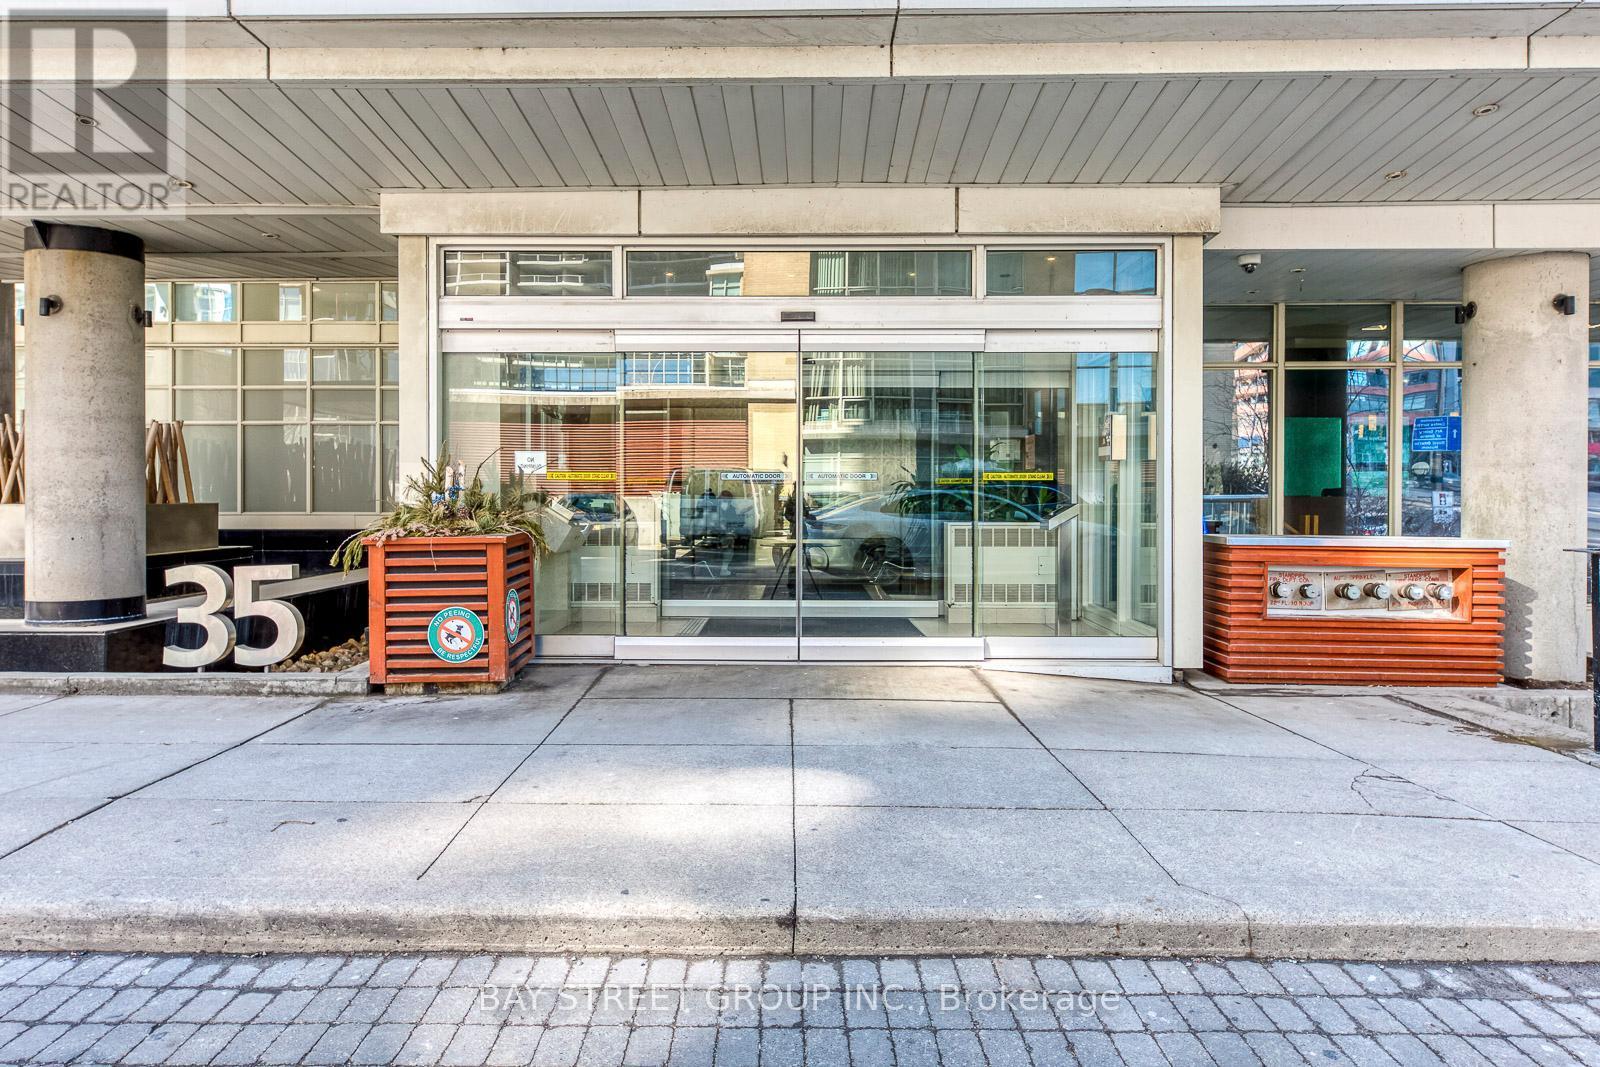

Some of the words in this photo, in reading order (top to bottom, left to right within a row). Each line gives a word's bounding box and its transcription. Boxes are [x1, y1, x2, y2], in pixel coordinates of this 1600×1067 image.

[162, 563, 306, 668] 35
[434, 616, 444, 627] NO
[444, 610, 470, 618] PEEING
[437, 647, 447, 656] BE
[447, 637, 482, 660] RESPECTFUL
